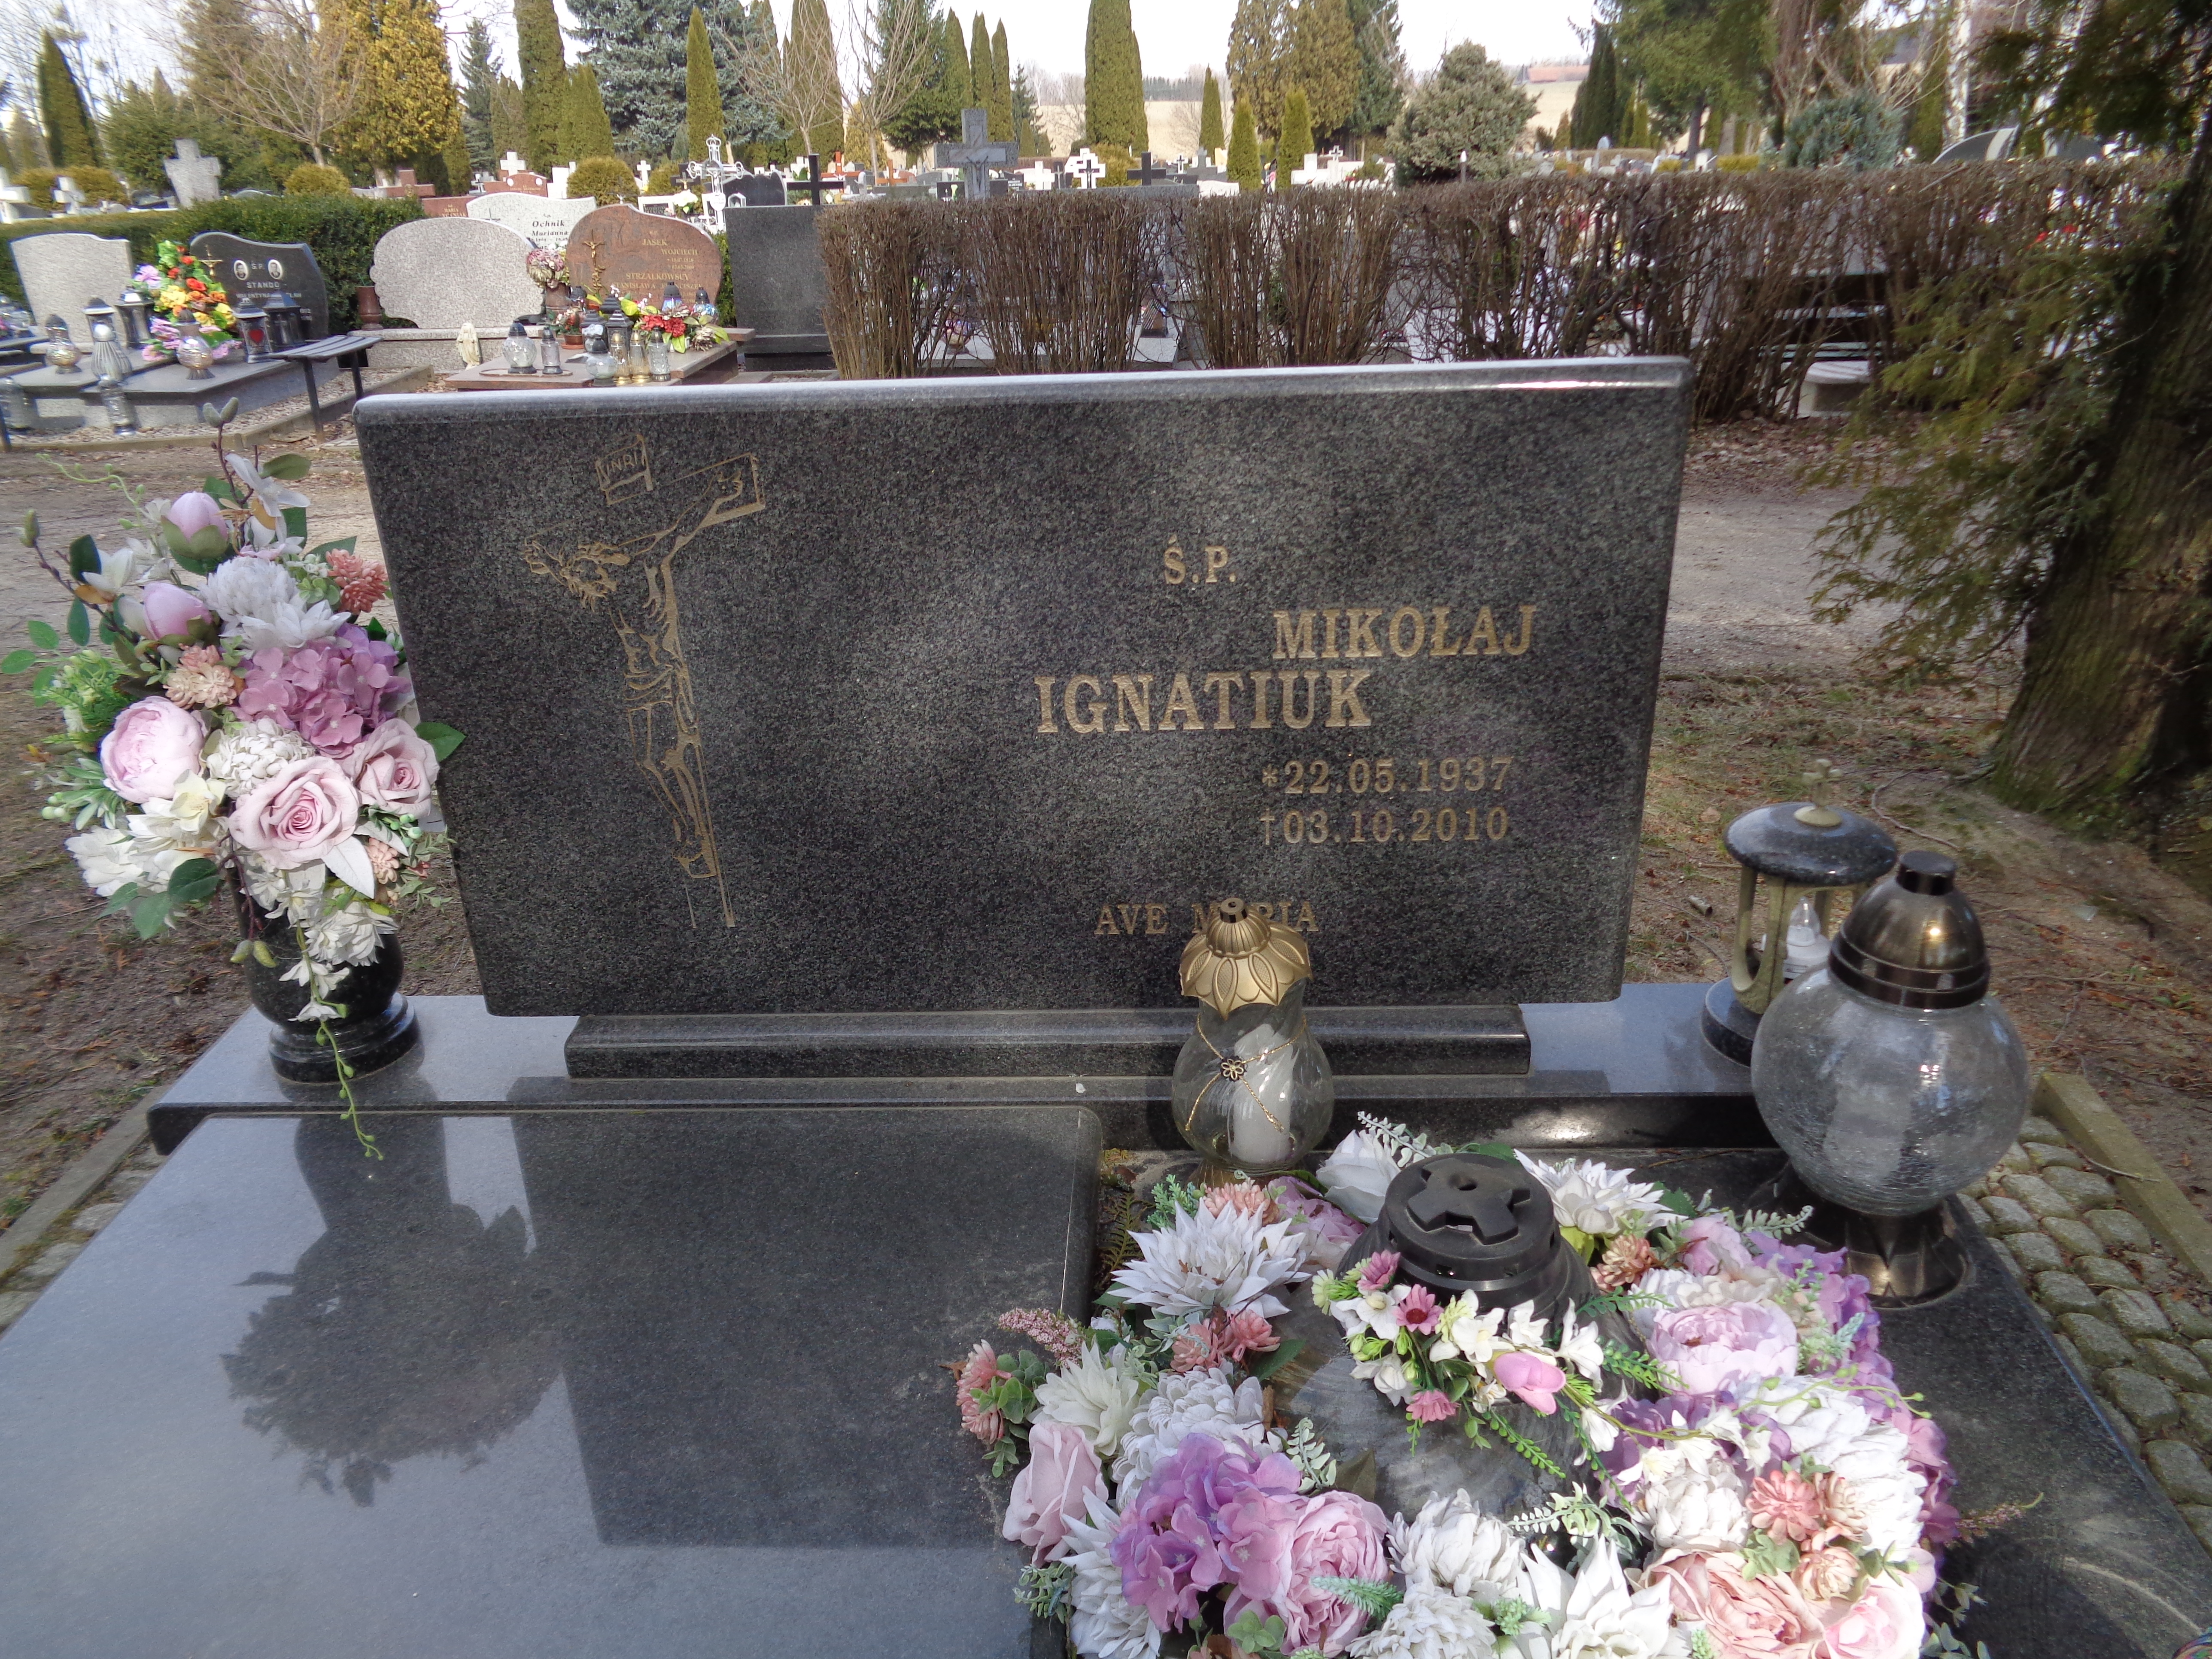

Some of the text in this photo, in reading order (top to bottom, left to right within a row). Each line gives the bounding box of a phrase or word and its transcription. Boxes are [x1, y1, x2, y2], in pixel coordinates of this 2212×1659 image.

[1164, 535, 1237, 585] Ś.P.
[1273, 605, 1536, 659] MIKOŁAJ
[1034, 669, 1373, 734] IGNATIUK
[1094, 903, 1170, 935] AVE
